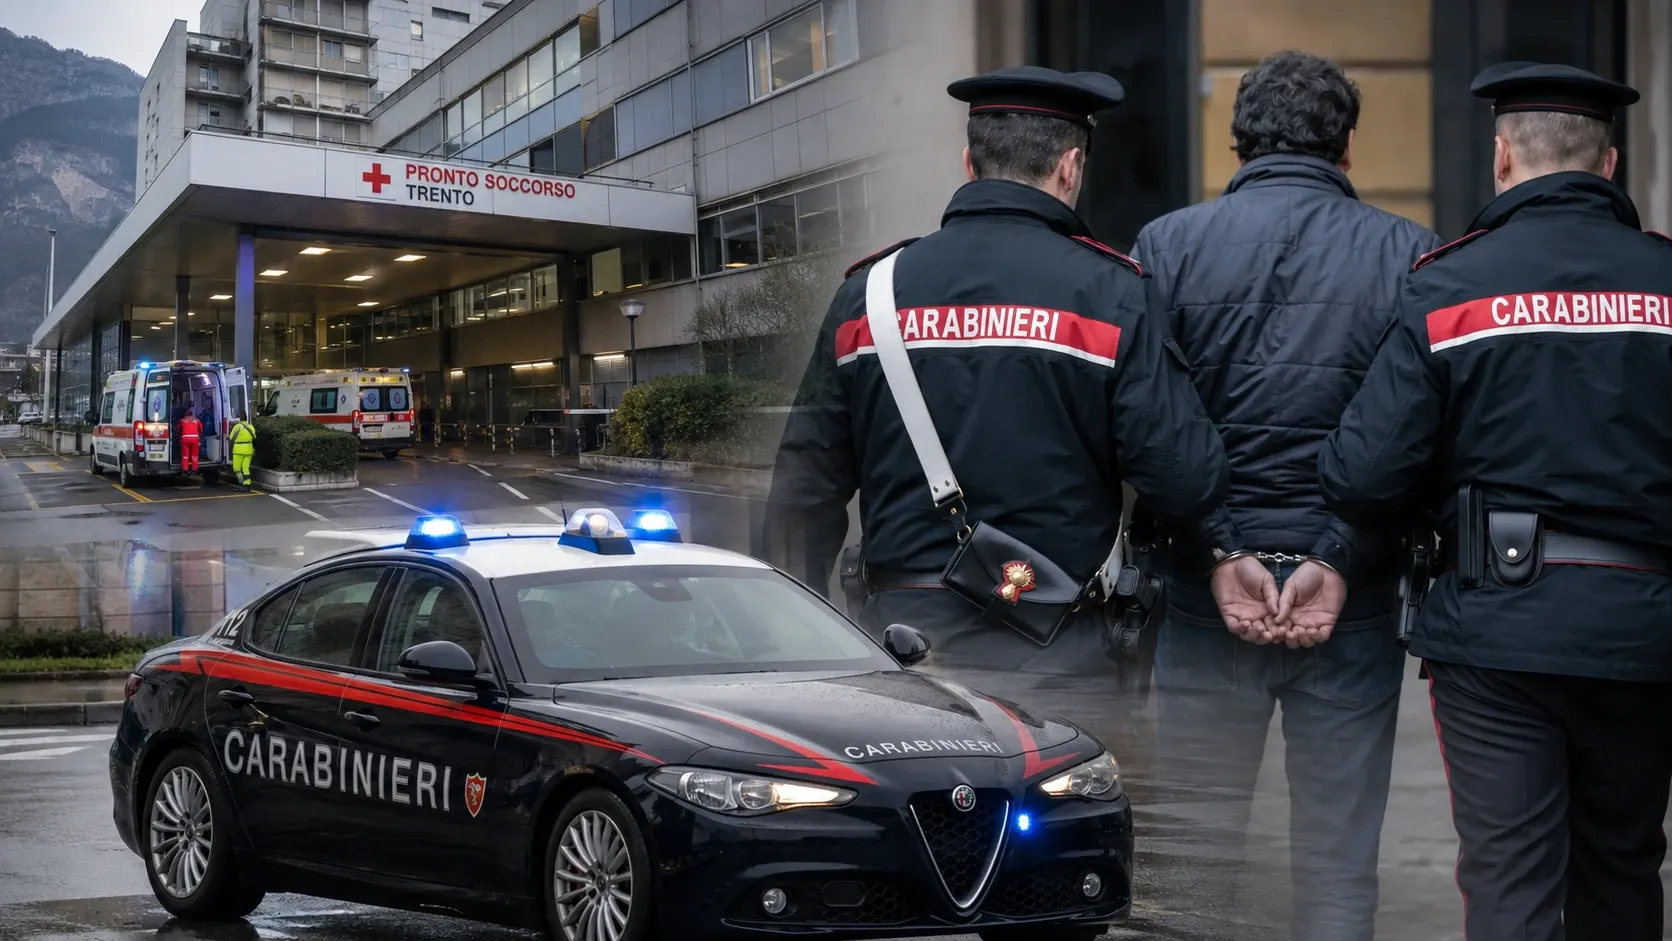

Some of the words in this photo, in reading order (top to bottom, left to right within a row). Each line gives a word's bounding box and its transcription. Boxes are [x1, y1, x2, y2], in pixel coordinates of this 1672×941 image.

[406, 163, 479, 188] PRONTO
[485, 173, 576, 199] SOCCORSO
[406, 184, 475, 206] TRENTO
[1491, 294, 1670, 326] CARABINIERI
[844, 739, 1004, 759] CARABINIERI
[224, 729, 452, 812] CARABINIERI
